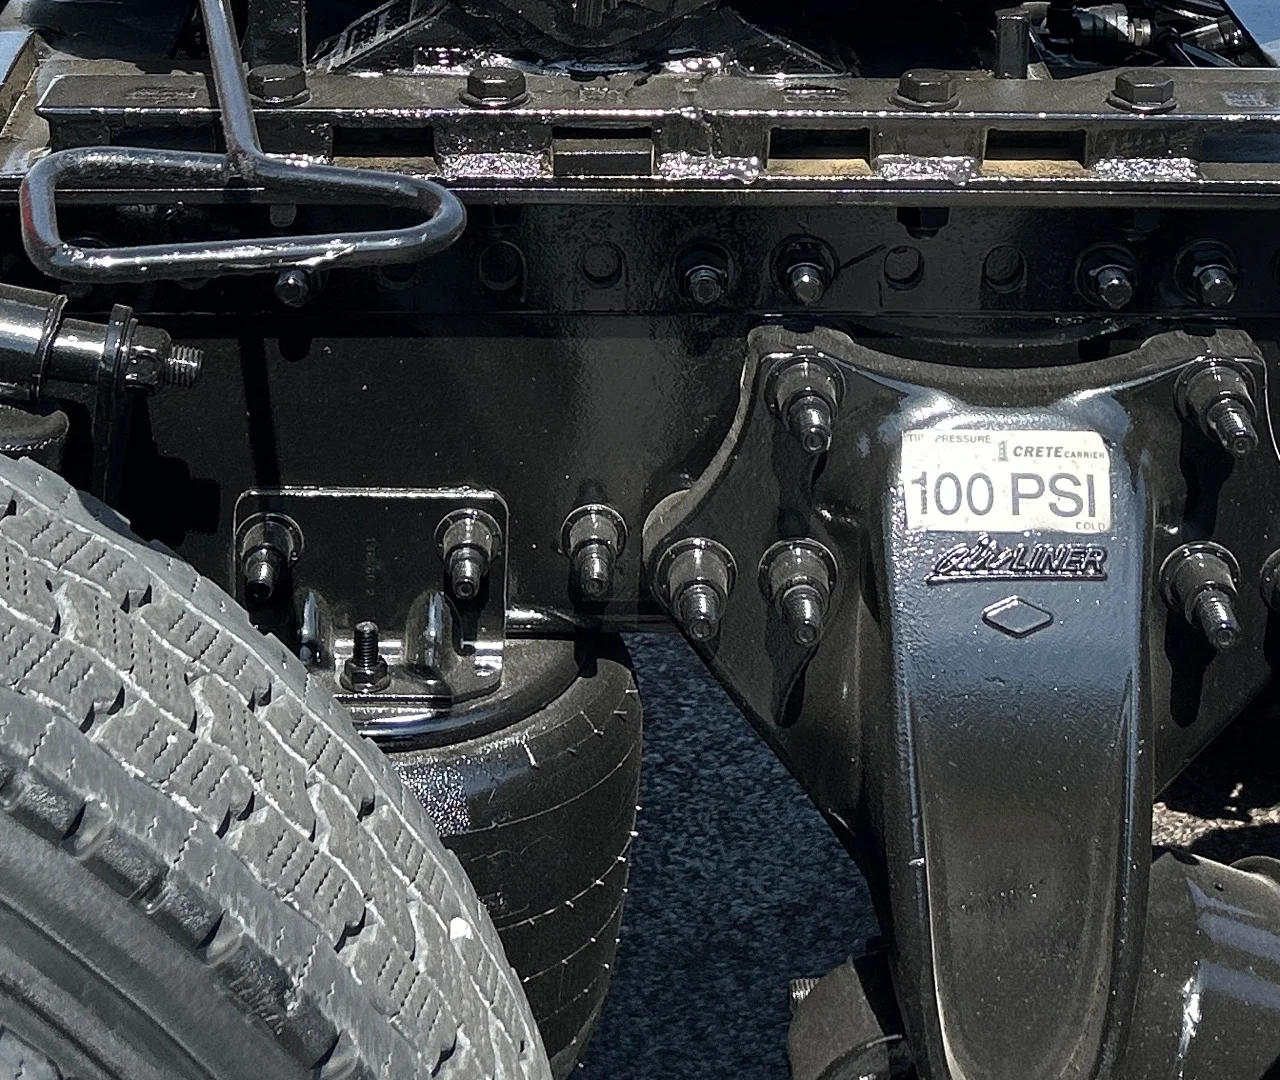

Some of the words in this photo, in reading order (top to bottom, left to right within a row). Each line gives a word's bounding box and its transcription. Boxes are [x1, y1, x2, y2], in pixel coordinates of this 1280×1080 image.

[935, 434, 991, 443] PRESSURE
[1013, 446, 1063, 457] CRETE
[911, 471, 994, 516] 100
[1011, 473, 1096, 517] PSI
[1076, 522, 1105, 530] COLD
